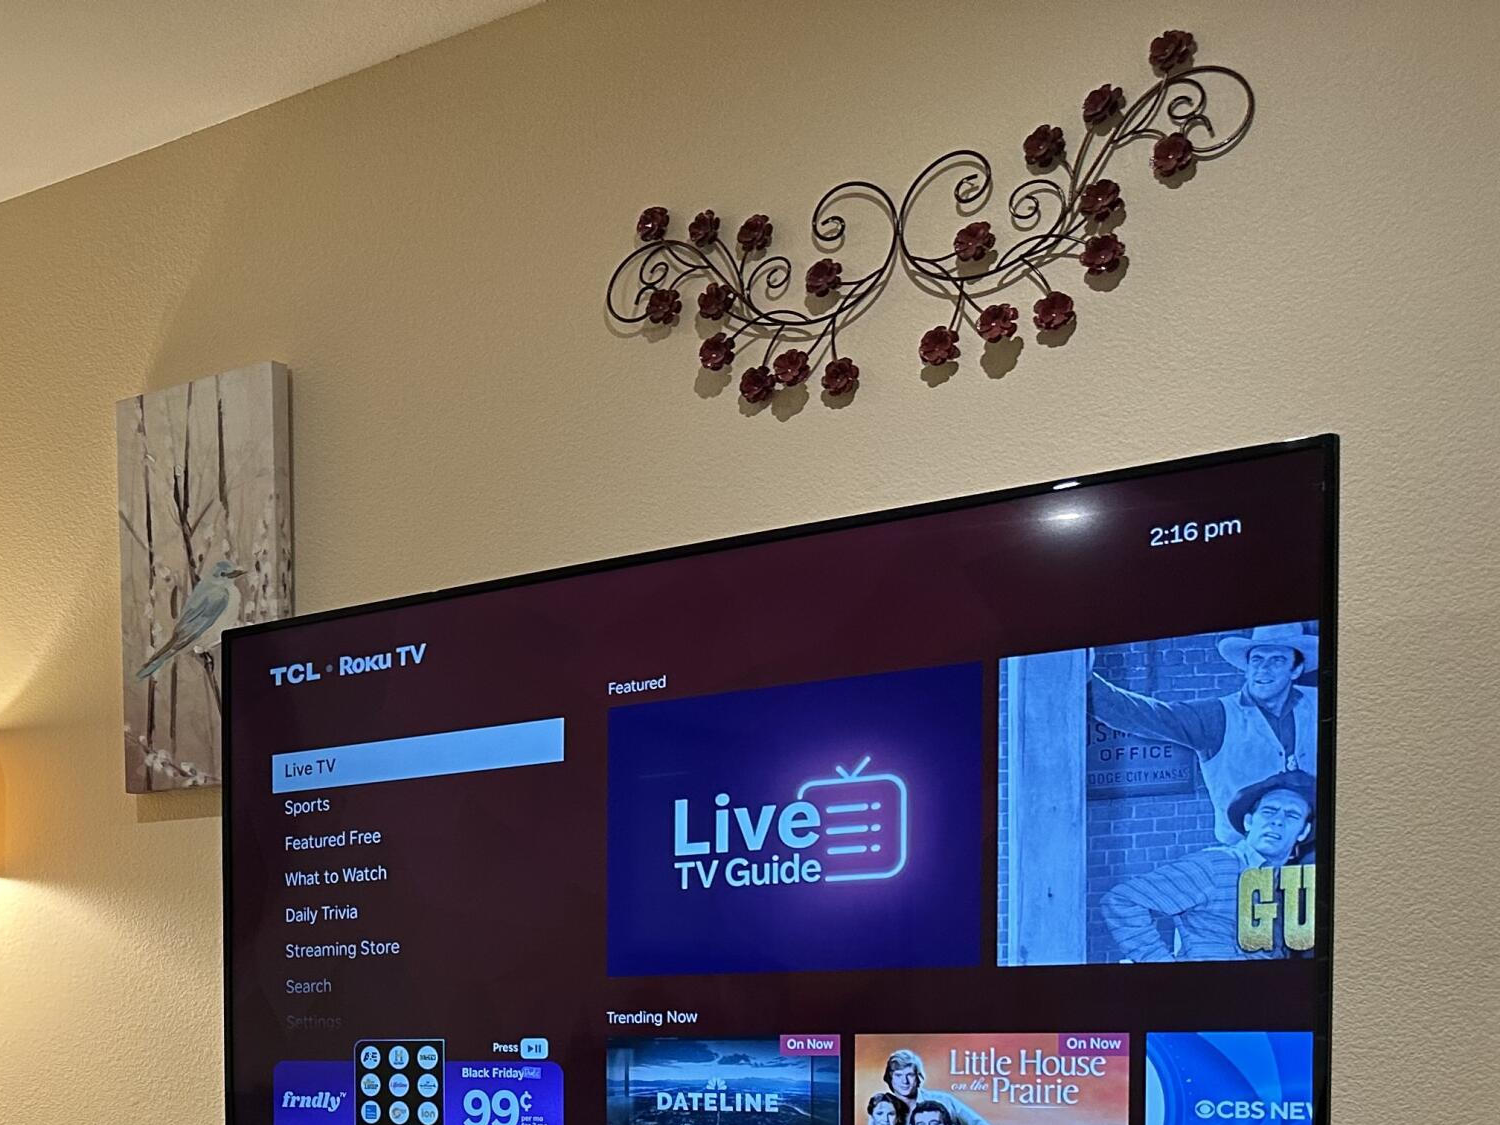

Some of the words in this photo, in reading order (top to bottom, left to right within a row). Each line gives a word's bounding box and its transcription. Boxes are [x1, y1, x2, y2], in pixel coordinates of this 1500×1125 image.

[1149, 522, 1198, 547] 2:16
[1204, 517, 1242, 543] pm
[270, 662, 321, 686] TCL
[339, 651, 391, 676] Roku
[395, 643, 427, 666] TV
[607, 675, 667, 695] Featured
[1100, 745, 1173, 761] OFFICE
[284, 762, 313, 778] Live
[316, 758, 336, 775] TV
[1126, 771, 1149, 782] CITY
[284, 798, 330, 816] Sports
[674, 793, 821, 856] Live
[285, 831, 346, 851] Featured
[350, 830, 382, 845] Free
[285, 871, 320, 887] What
[324, 870, 339, 885] to
[342, 865, 387, 883] Watch
[674, 860, 719, 890] TV
[725, 853, 821, 887] Guide
[285, 906, 318, 924] Daily
[321, 905, 358, 920] Trivia
[285, 941, 357, 959] Streaming
[360, 940, 400, 955] Store
[285, 978, 332, 994] Search
[606, 1010, 663, 1026] Trending
[667, 1011, 698, 1024] Now
[493, 1042, 519, 1053] Press
[786, 1039, 804, 1050] On
[806, 1039, 834, 1050] Now
[1066, 1037, 1087, 1050] On
[1089, 1038, 1122, 1050] Now
[950, 1048, 1012, 1077] Little
[1020, 1050, 1106, 1077] House
[461, 1067, 490, 1078] Black
[492, 1067, 525, 1081] Friday
[950, 1082, 968, 1092] on
[969, 1078, 989, 1092] the
[991, 1077, 1080, 1106] Prairie
[282, 1091, 341, 1113] frndly
[657, 1092, 780, 1113] DATELINE
[1216, 1100, 1265, 1120] CBS
